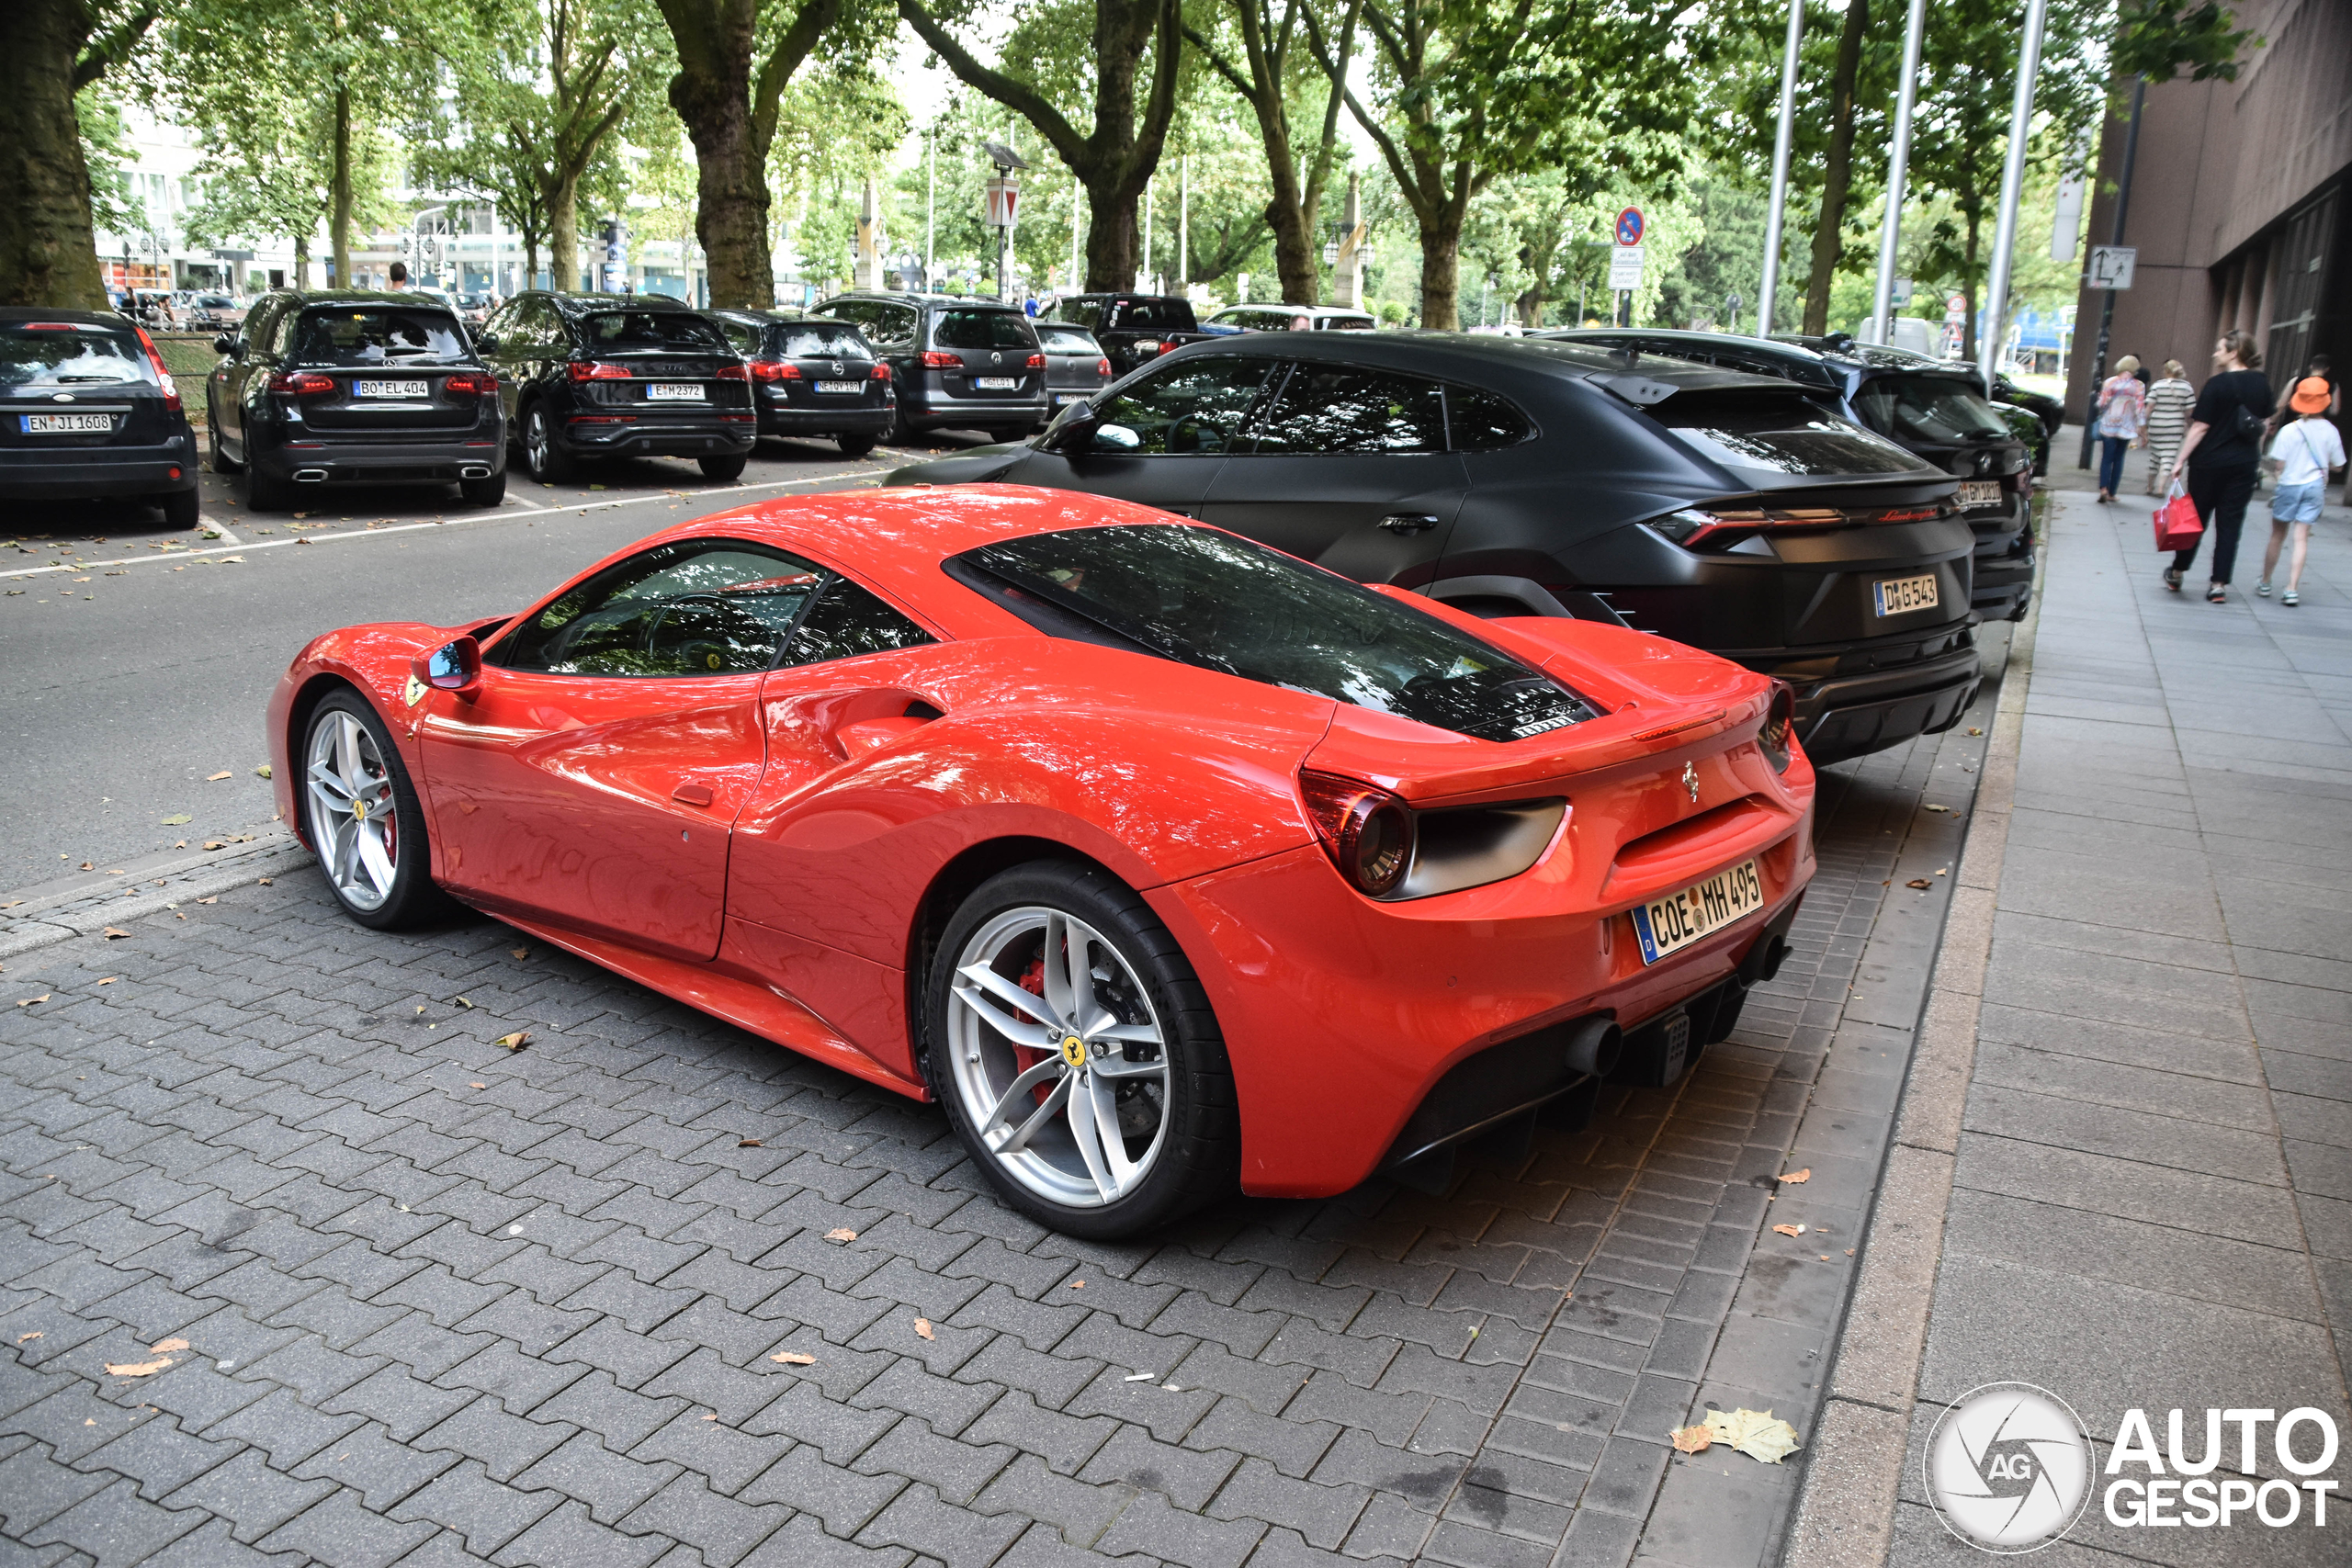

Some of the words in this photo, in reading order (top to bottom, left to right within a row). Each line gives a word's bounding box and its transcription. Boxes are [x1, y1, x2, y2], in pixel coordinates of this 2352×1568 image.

[1951, 299, 1962, 308] 30
[361, 382, 378, 394] BO
[386, 382, 401, 394] EL
[404, 382, 425, 394] 404
[818, 381, 829, 390] NE
[845, 381, 858, 390] 189
[983, 378, 992, 386] MG
[656, 385, 662, 395] E
[668, 385, 675, 395] M
[676, 385, 700, 395] 2372
[29, 417, 48, 430] EN
[58, 416, 76, 430] JI
[76, 416, 109, 429] 1608
[1969, 484, 1981, 501] GM
[1981, 483, 2001, 501] 1810
[1878, 508, 1938, 522] Lamborghini
[1884, 583, 1895, 611] D
[1901, 581, 1912, 608] G
[1911, 578, 1936, 606] 543
[1510, 716, 1577, 738] Ferrari
[1651, 894, 1695, 948] COE
[1701, 876, 1730, 925] MH
[1728, 862, 1759, 910] 495
[1645, 939, 1652, 952] D
